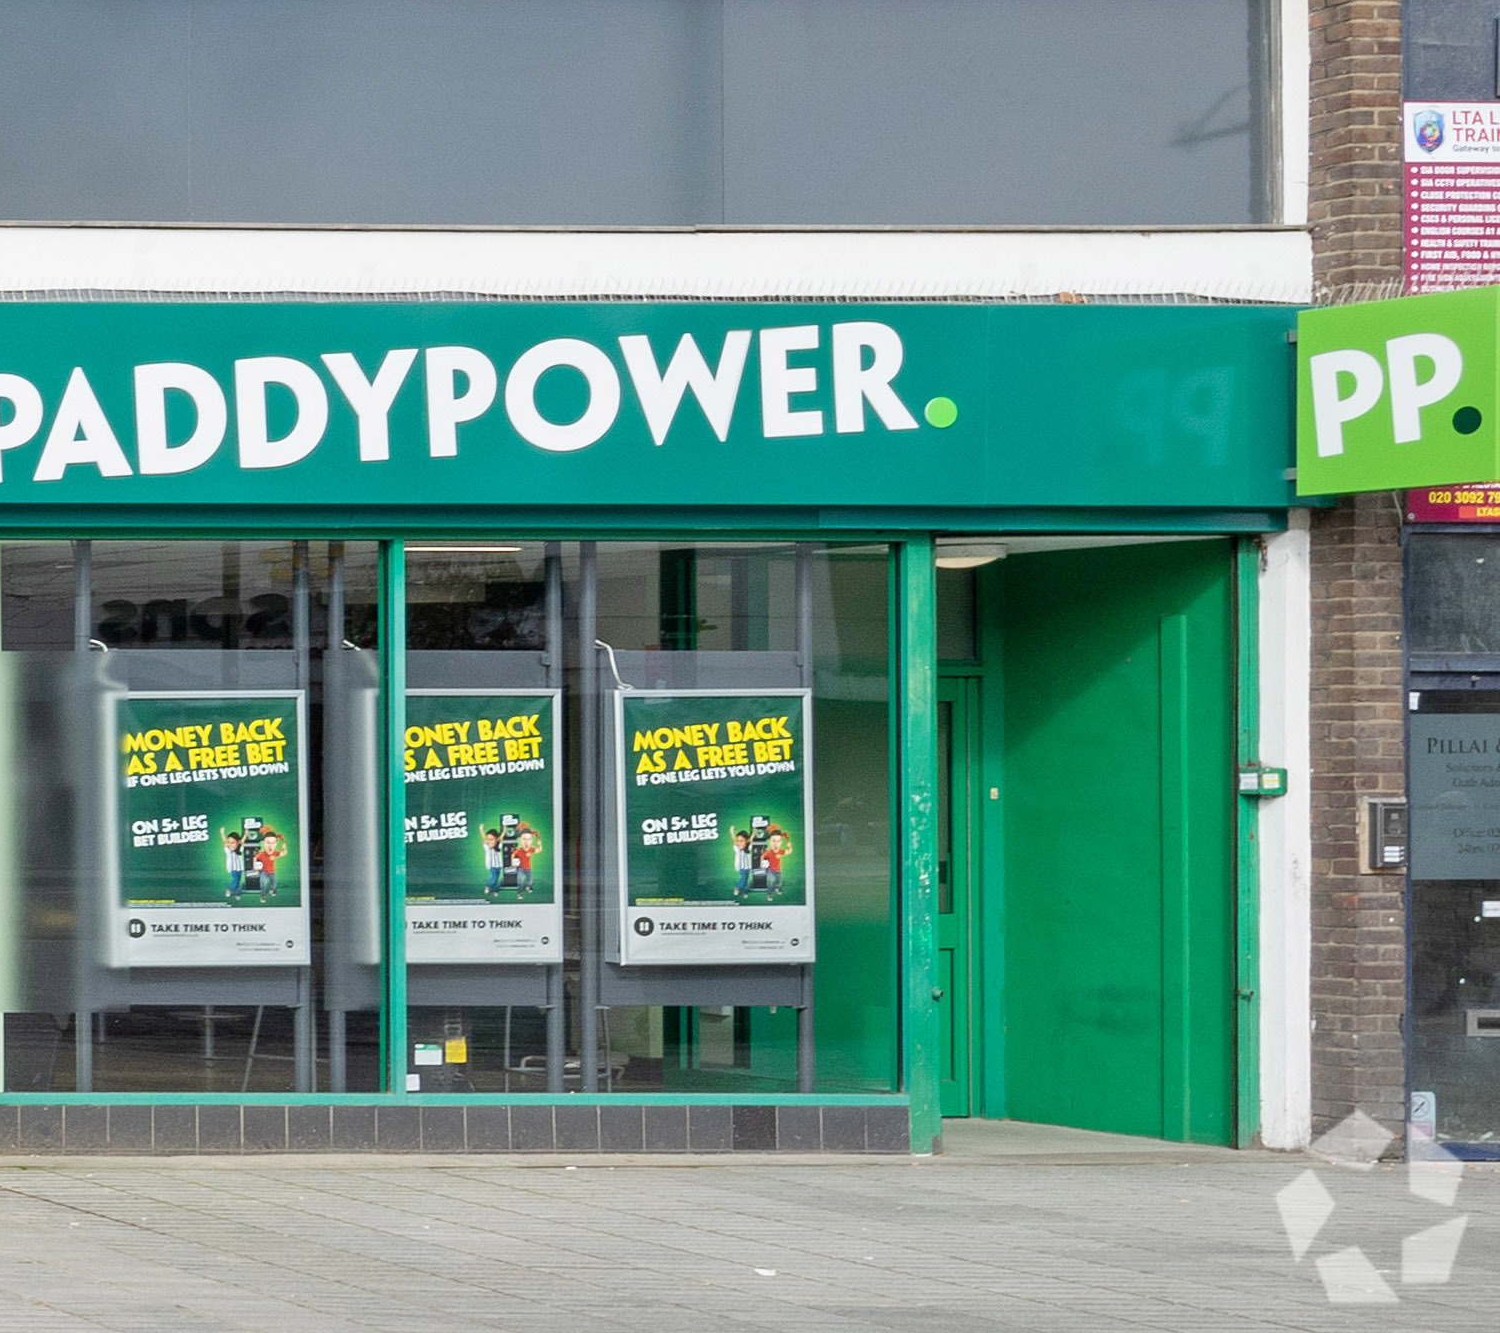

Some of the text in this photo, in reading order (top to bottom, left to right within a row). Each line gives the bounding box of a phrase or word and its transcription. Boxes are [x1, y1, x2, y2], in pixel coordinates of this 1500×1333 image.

[633, 717, 791, 752] MONEY BACK
[636, 739, 793, 773] AS A FREE BET
[636, 760, 795, 786] IF ONE LEG LETS YOU DOWN
[642, 813, 717, 832] ON 5+ LEG
[643, 828, 719, 845] BET BUILDERS
[722, 922, 735, 930] TO
